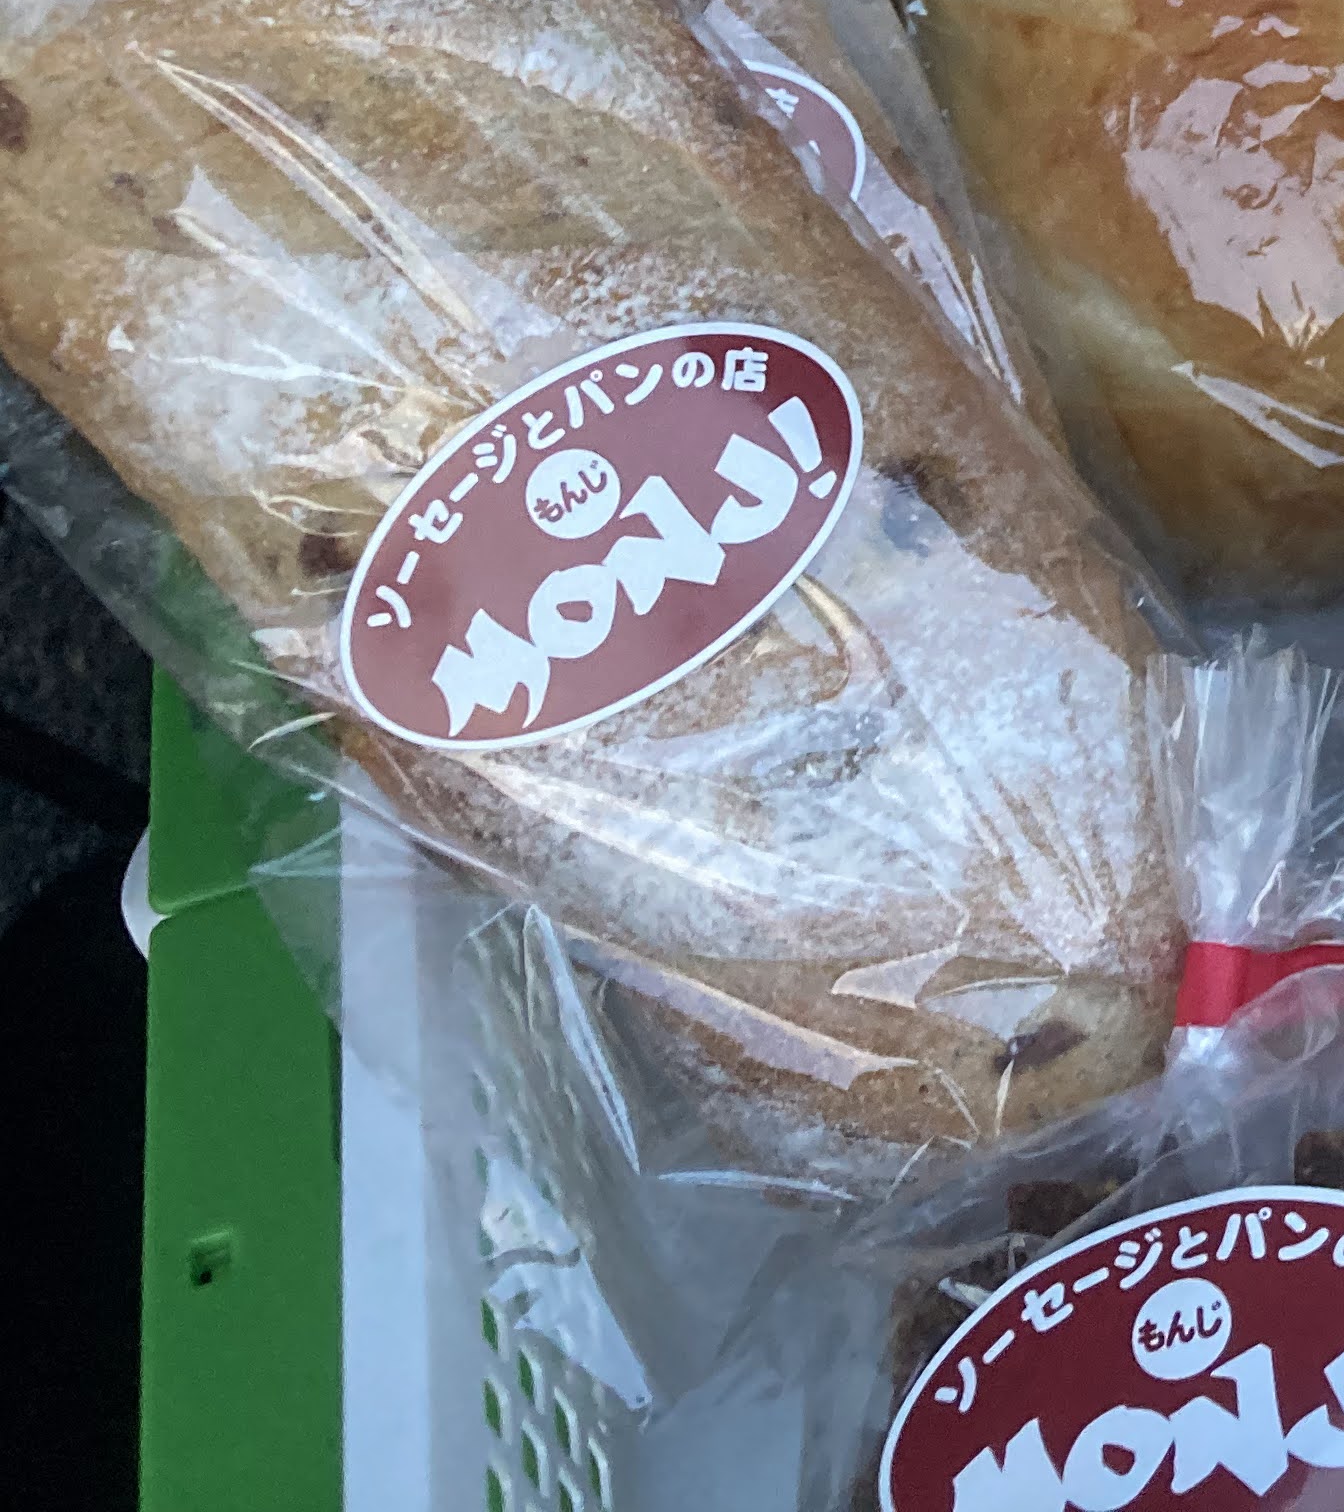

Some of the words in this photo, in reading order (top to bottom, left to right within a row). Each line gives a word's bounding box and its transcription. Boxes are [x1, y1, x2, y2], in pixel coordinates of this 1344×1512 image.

[367, 347, 769, 630] ソーセージとパンの店
[533, 459, 608, 525] もんじ
[1137, 1298, 1223, 1354] もんじ
